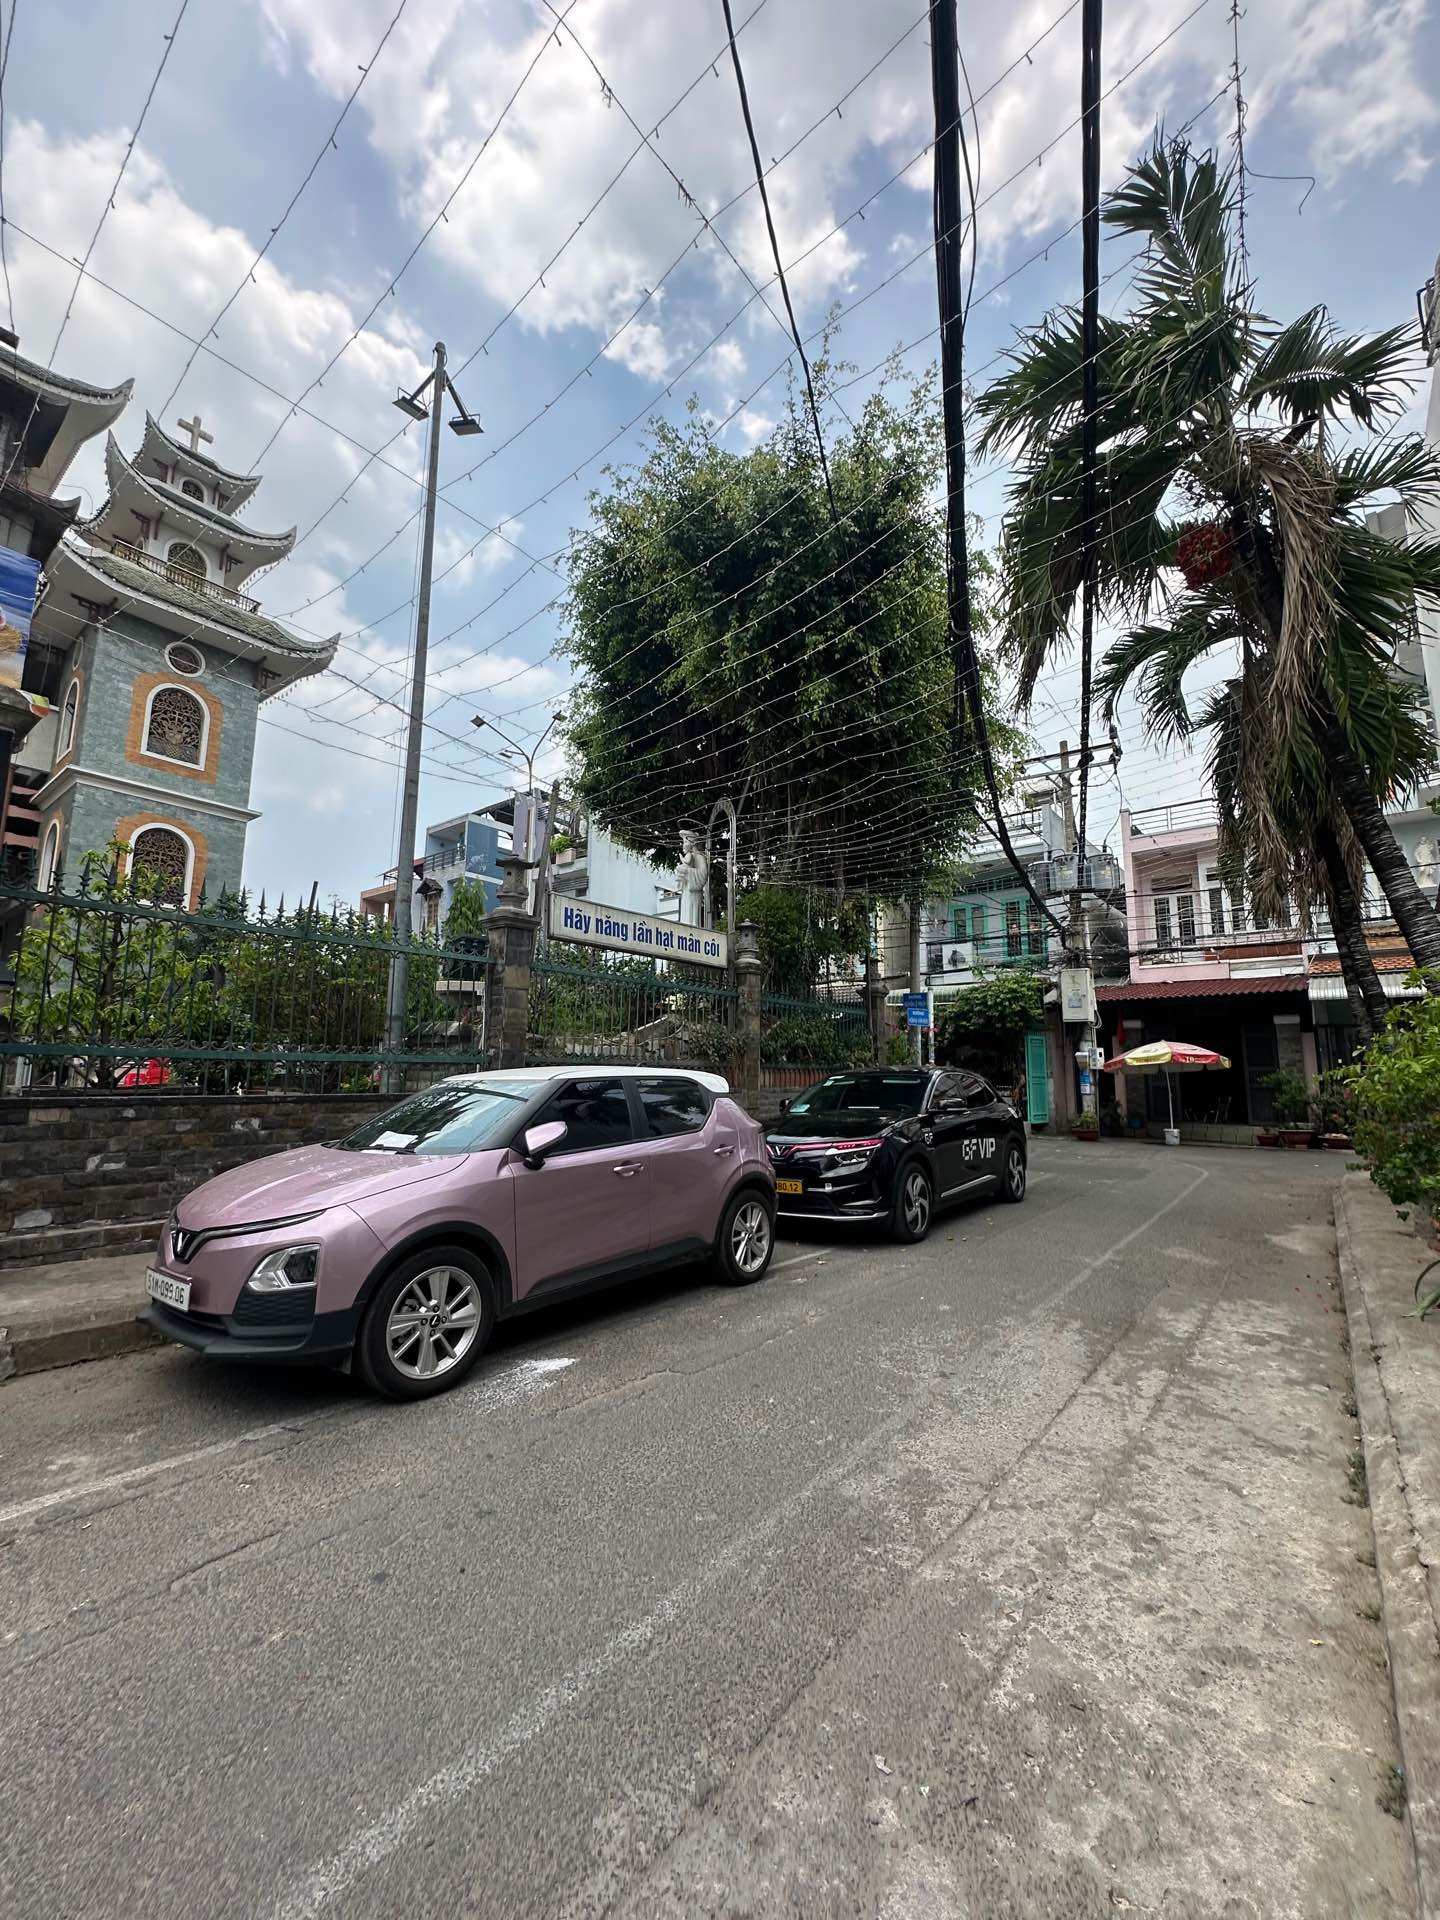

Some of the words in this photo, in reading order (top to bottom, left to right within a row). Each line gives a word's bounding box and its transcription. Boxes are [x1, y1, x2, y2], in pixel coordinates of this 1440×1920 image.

[563, 907, 592, 934] Hãy
[595, 915, 628, 942] năng
[633, 920, 652, 944] lần
[655, 927, 674, 952] hạt
[677, 933, 701, 954] mân
[704, 937, 720, 957] côi
[978, 1137, 996, 1159] VIP
